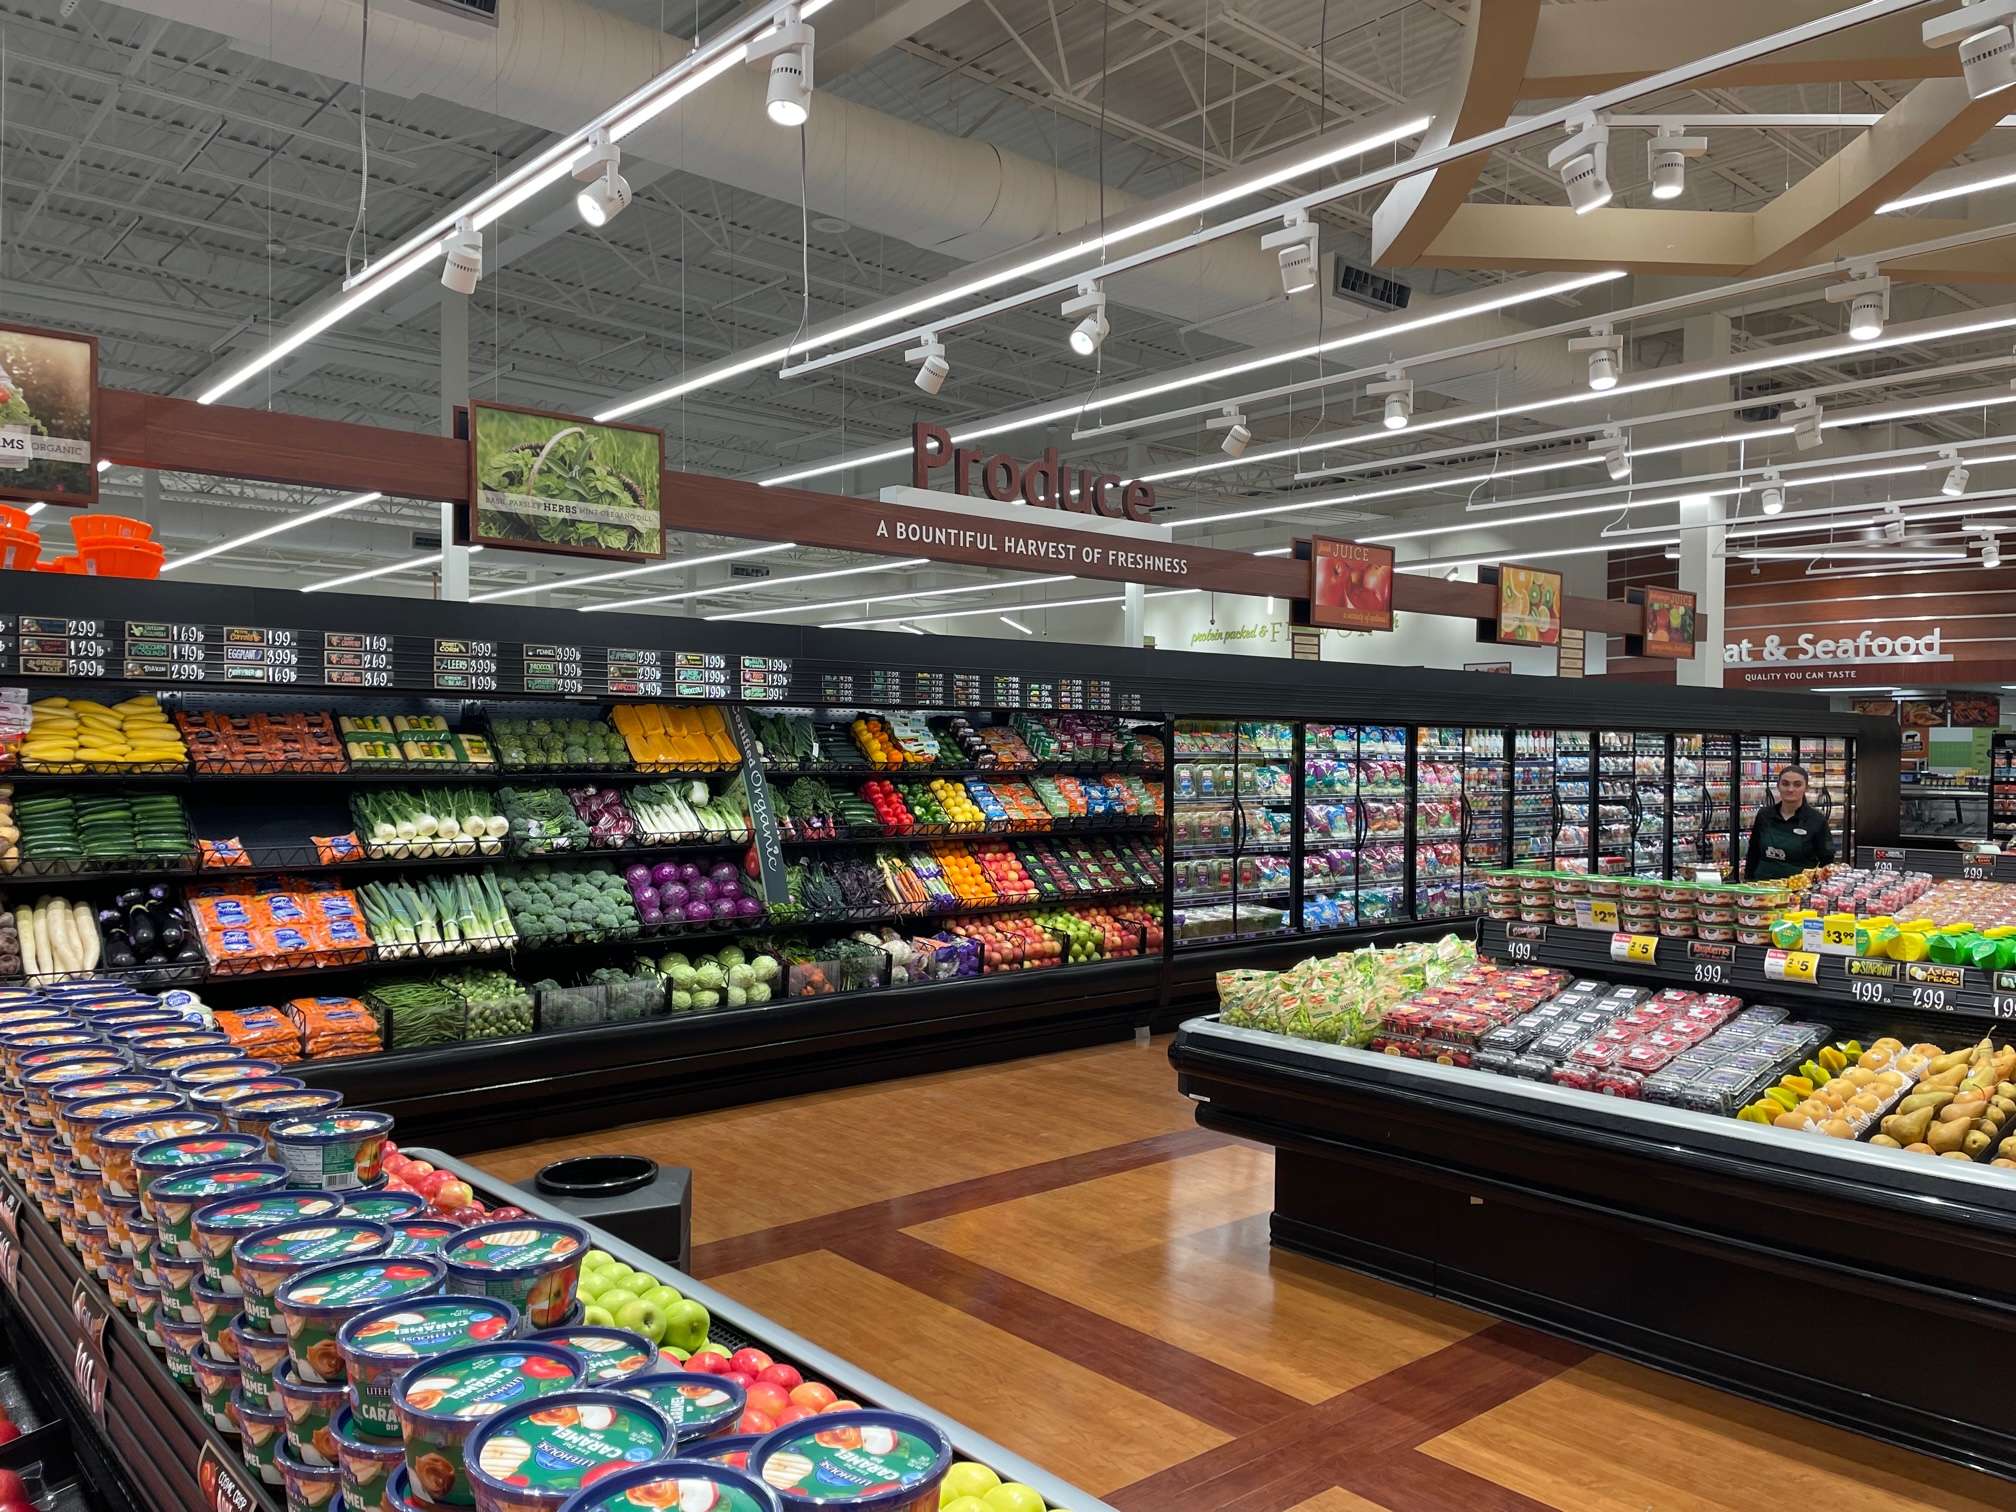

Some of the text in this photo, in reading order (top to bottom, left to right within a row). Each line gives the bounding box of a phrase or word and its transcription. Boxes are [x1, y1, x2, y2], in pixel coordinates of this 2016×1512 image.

[0, 437, 82, 455] MS ORGANIC
[913, 421, 1156, 523] Produce
[543, 502, 577, 515] HERBS
[877, 520, 1188, 575] A BOUNTIFUL HARVEST OF FRESHNESS
[1333, 544, 1369, 561] JUICE
[1224, 625, 1257, 644] packed
[1259, 625, 1268, 638] &
[1723, 628, 1940, 663] at & Seafood
[1745, 670, 1857, 681] QUALITY YOU CAN TASTE
[751, 770, 779, 872] Organic
[1927, 976, 1959, 985] PEARS
[366, 1386, 391, 1397] LITEH
[444, 1367, 513, 1400] CARAMEL
[362, 1404, 400, 1422] CARA
[537, 1441, 597, 1468] LITEHOUSE
[551, 1427, 624, 1459] CARAMEL
[834, 1449, 900, 1481] CARAMEL
